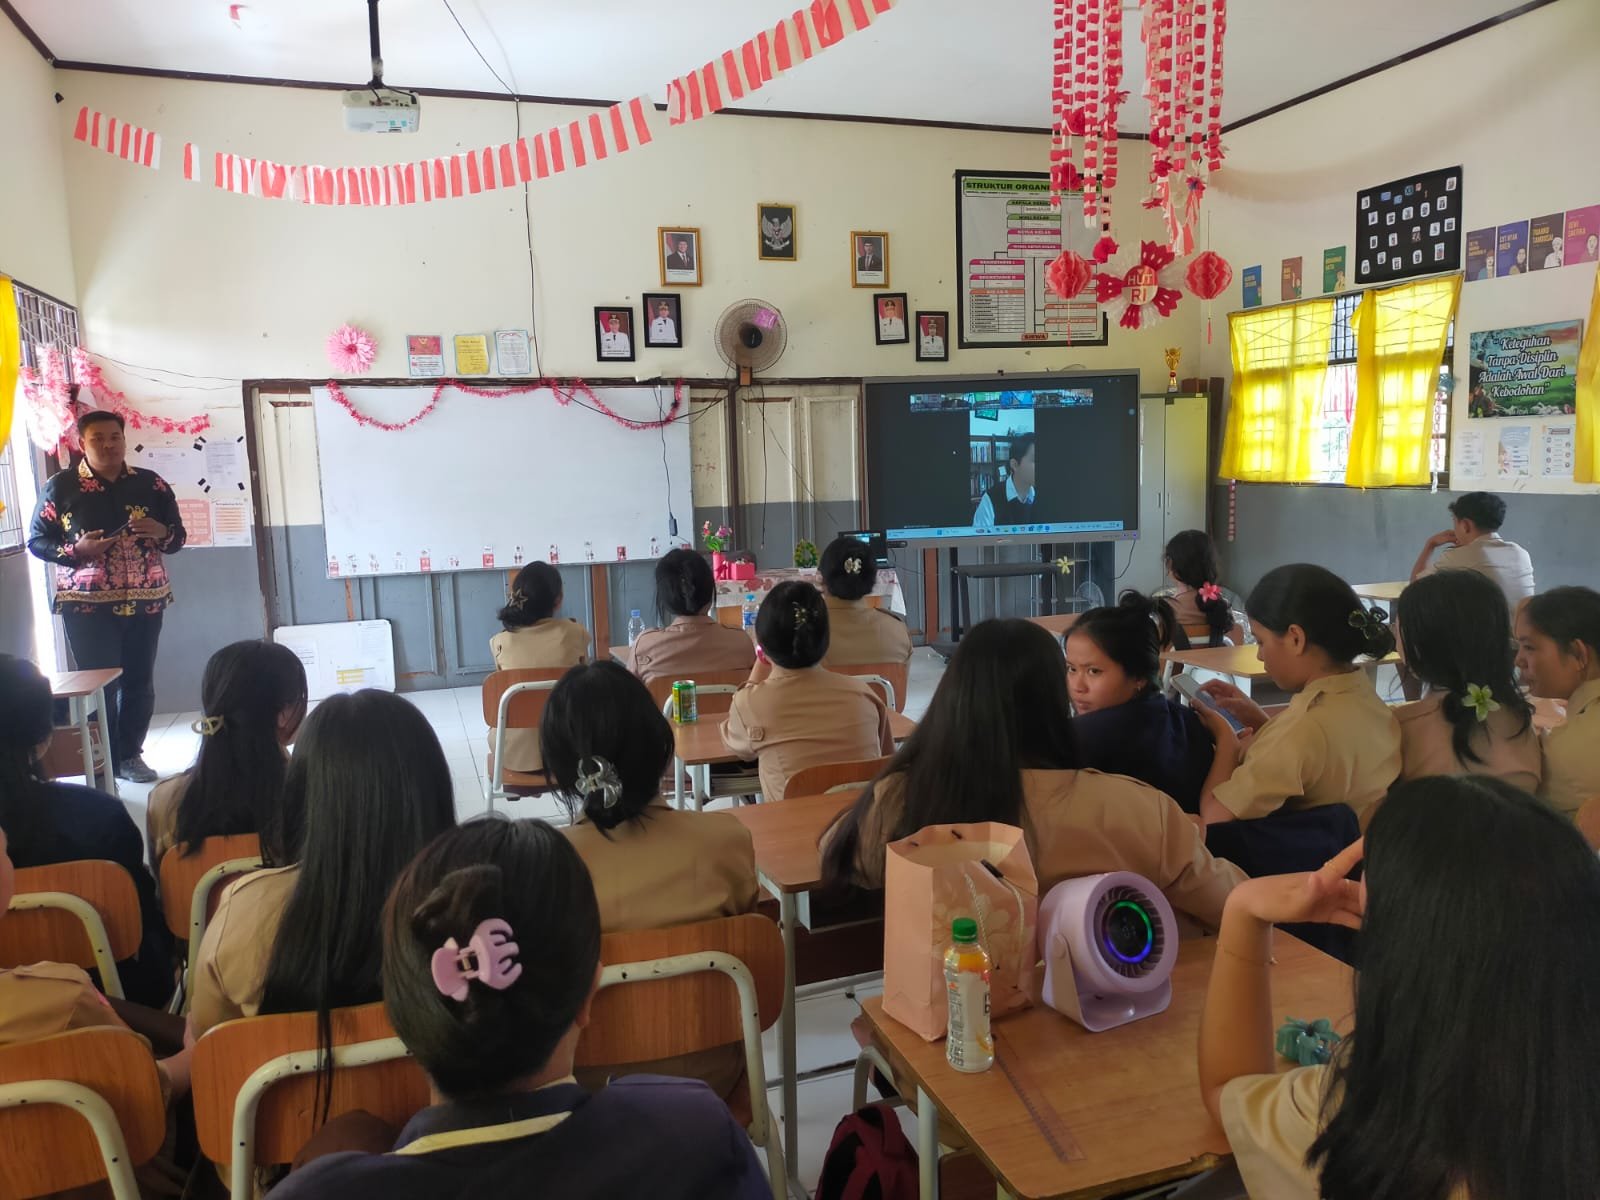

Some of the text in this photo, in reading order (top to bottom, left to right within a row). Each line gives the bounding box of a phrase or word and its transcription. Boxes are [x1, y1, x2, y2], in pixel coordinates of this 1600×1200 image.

[966, 182, 1013, 190] STRUKTUR
[1127, 274, 1152, 285] HUT
[1131, 288, 1147, 302] RI
[1488, 350, 1558, 368] Tanpa Disiplin
[1479, 365, 1566, 382] Adalah Awal Dari
